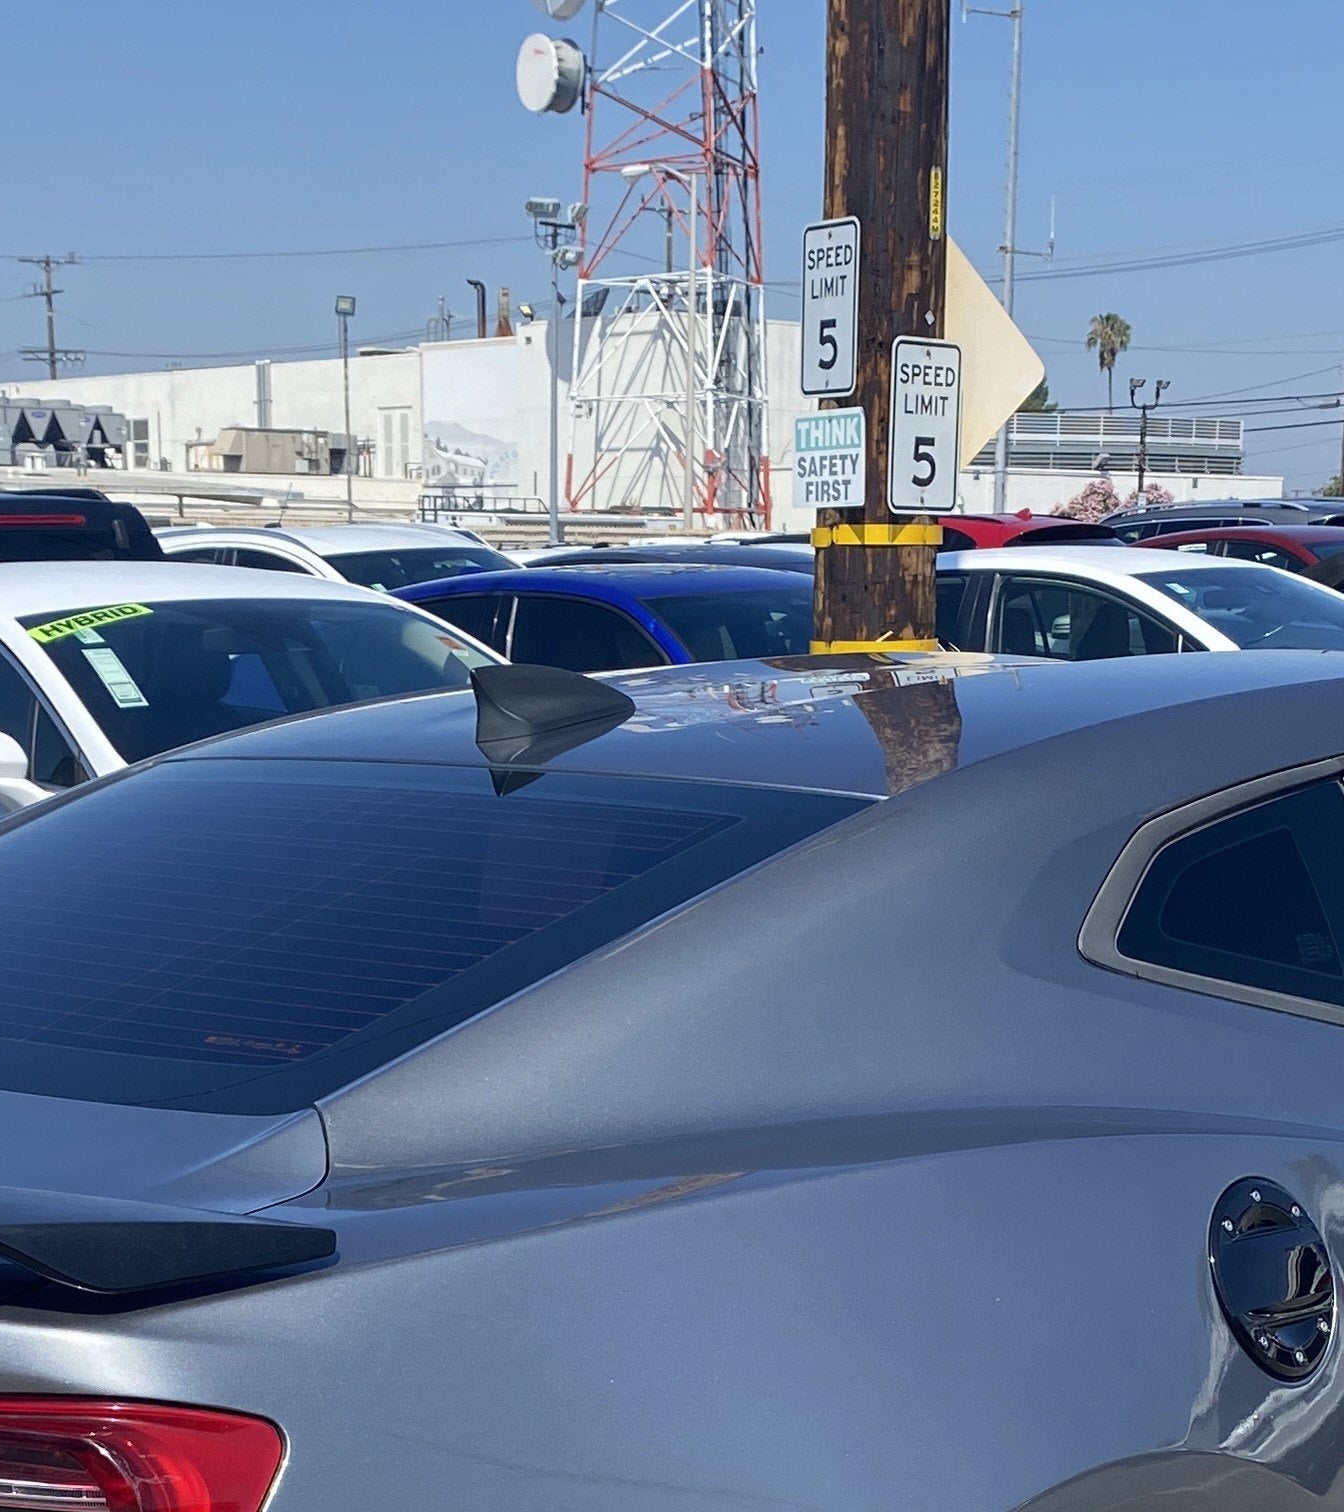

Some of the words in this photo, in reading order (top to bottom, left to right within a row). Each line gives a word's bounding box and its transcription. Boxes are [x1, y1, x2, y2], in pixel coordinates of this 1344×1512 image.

[807, 243, 852, 271] SPEED
[811, 274, 847, 301] LIMIT
[818, 318, 838, 370] 5
[899, 363, 955, 388] SPEED
[904, 393, 949, 418] LIMIT
[796, 416, 861, 449] THINK
[796, 453, 860, 481] SAFETY
[911, 436, 937, 488] 5
[805, 480, 852, 503] FIRST
[39, 604, 139, 637] HYBRID
